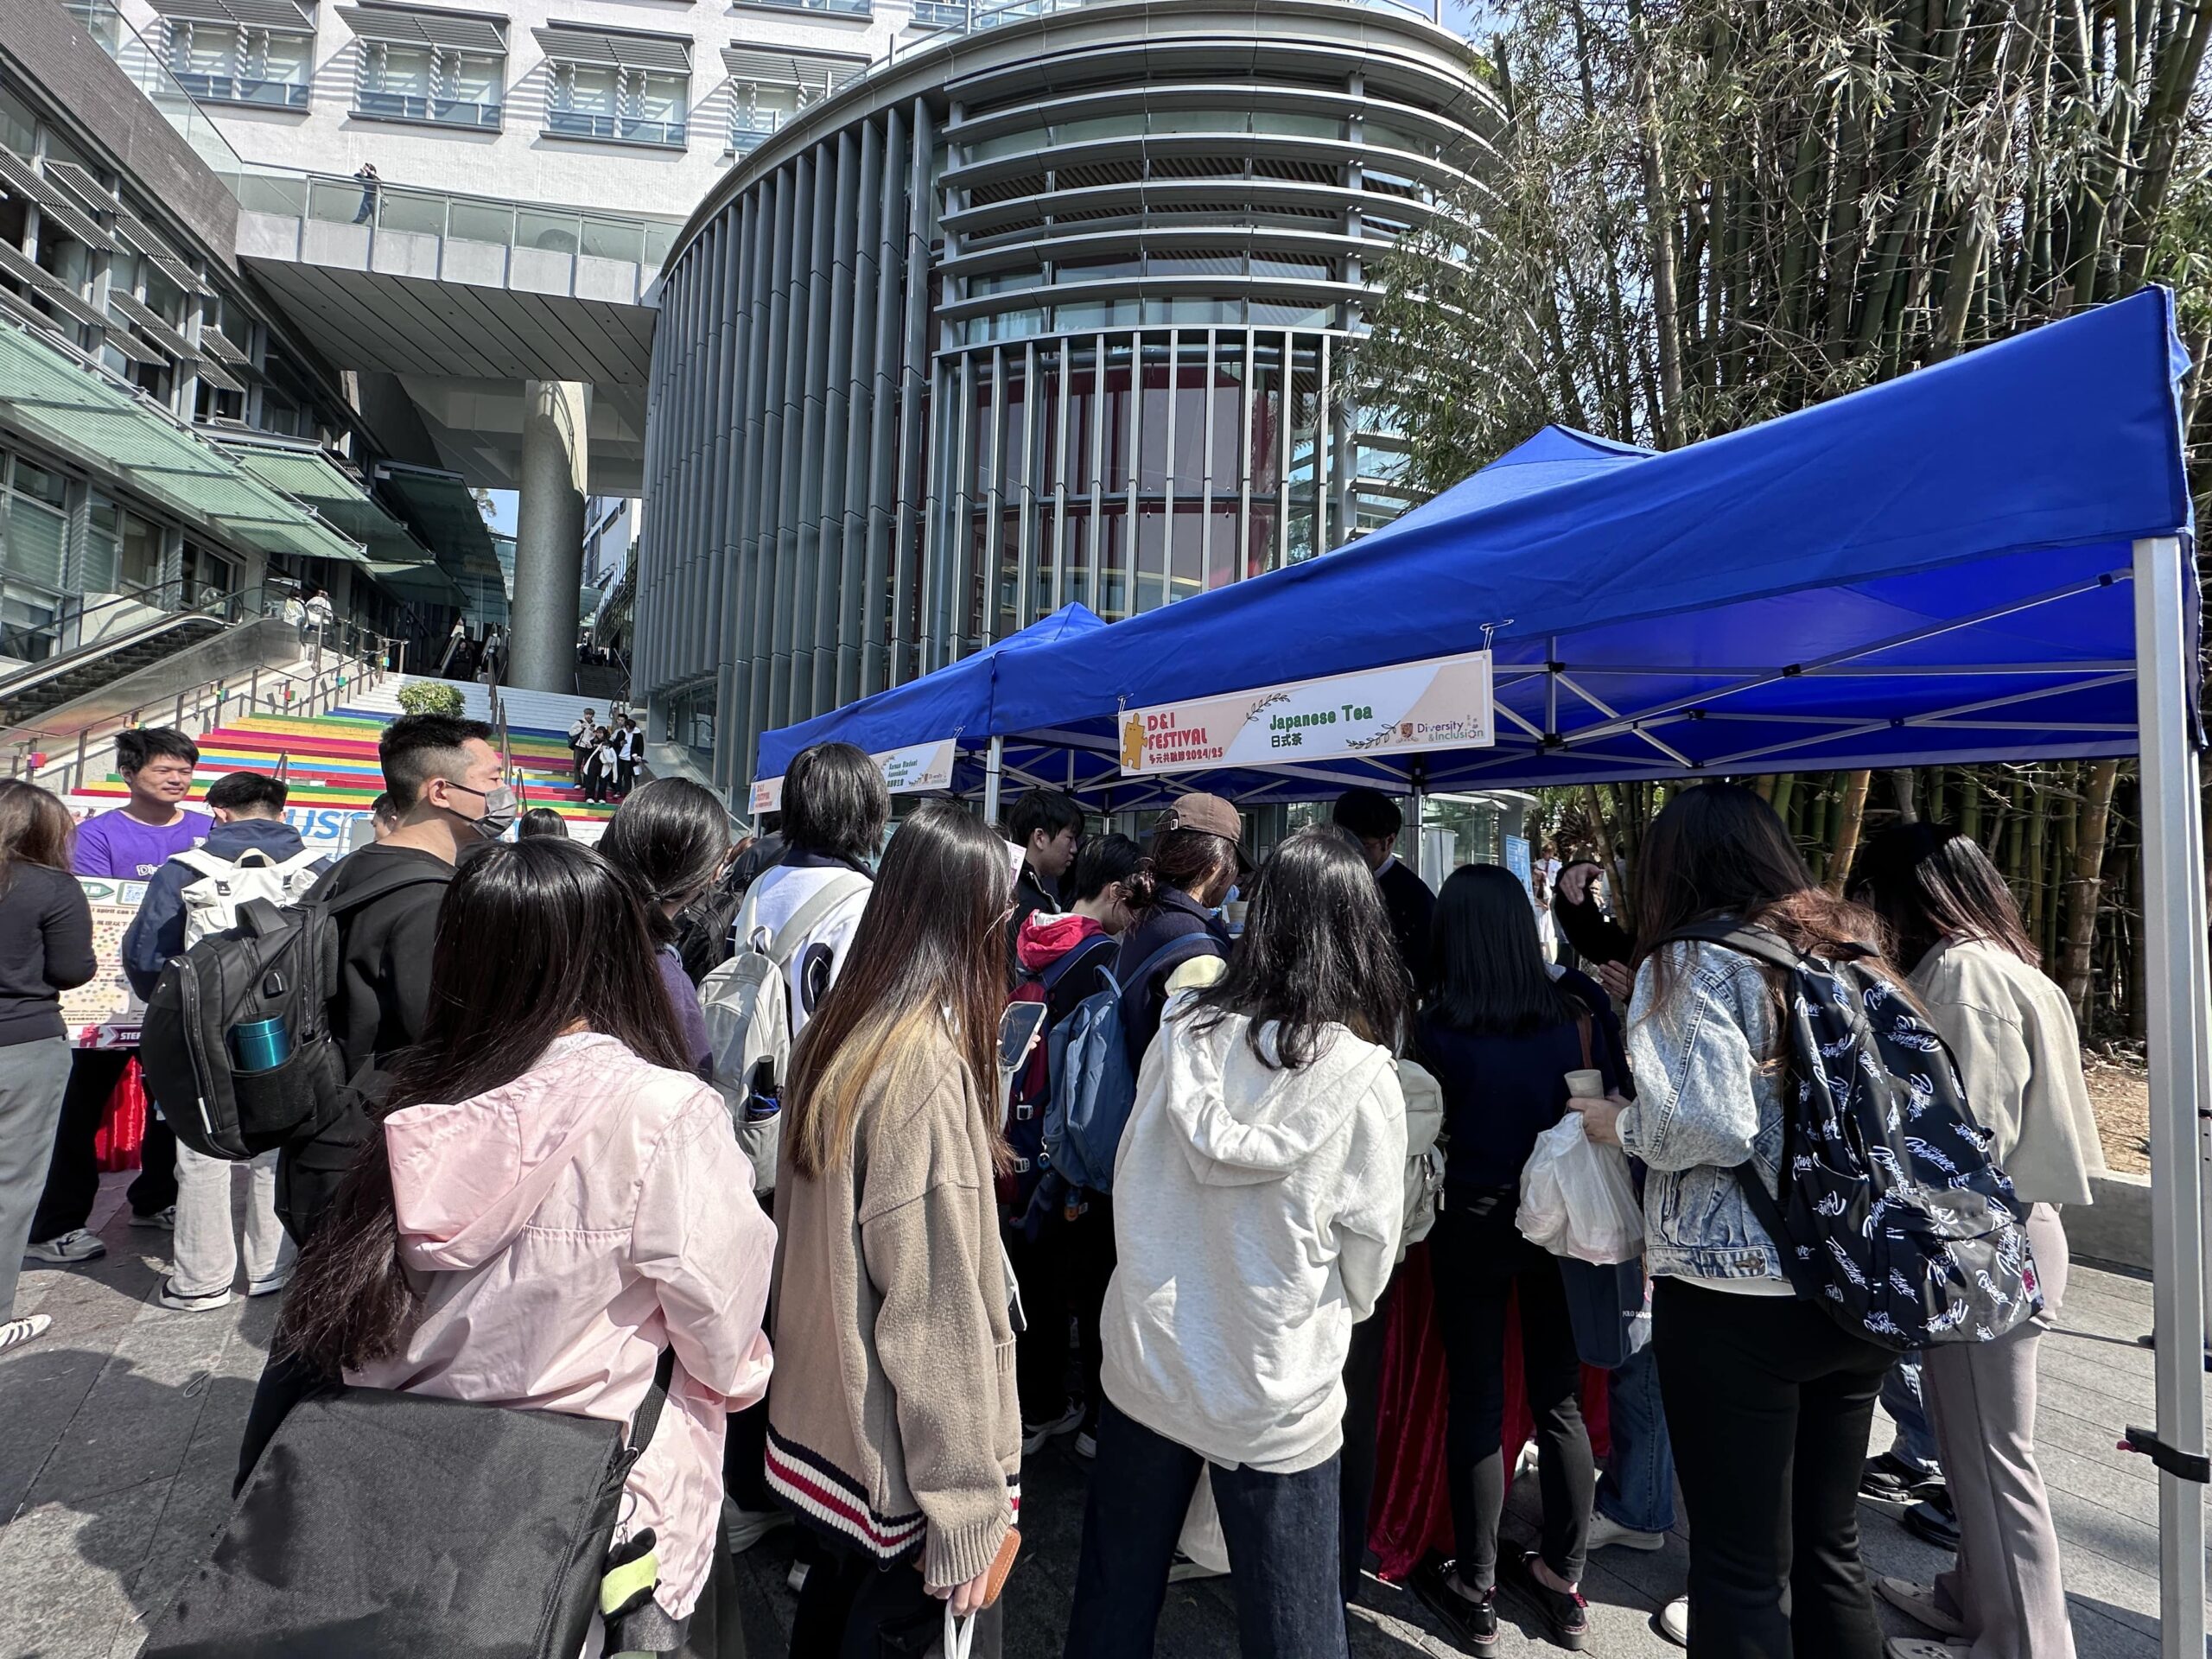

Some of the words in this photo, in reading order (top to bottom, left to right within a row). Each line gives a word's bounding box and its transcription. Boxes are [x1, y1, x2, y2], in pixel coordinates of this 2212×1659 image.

[1269, 714, 1337, 733] Japanese
[1341, 704, 1373, 721] Tea
[1417, 721, 1465, 734] Diversity
[1147, 728, 1208, 750] FESTIVAL
[1271, 732, 1303, 748] 日式茶
[1904, 1136, 1960, 1175] Positive
